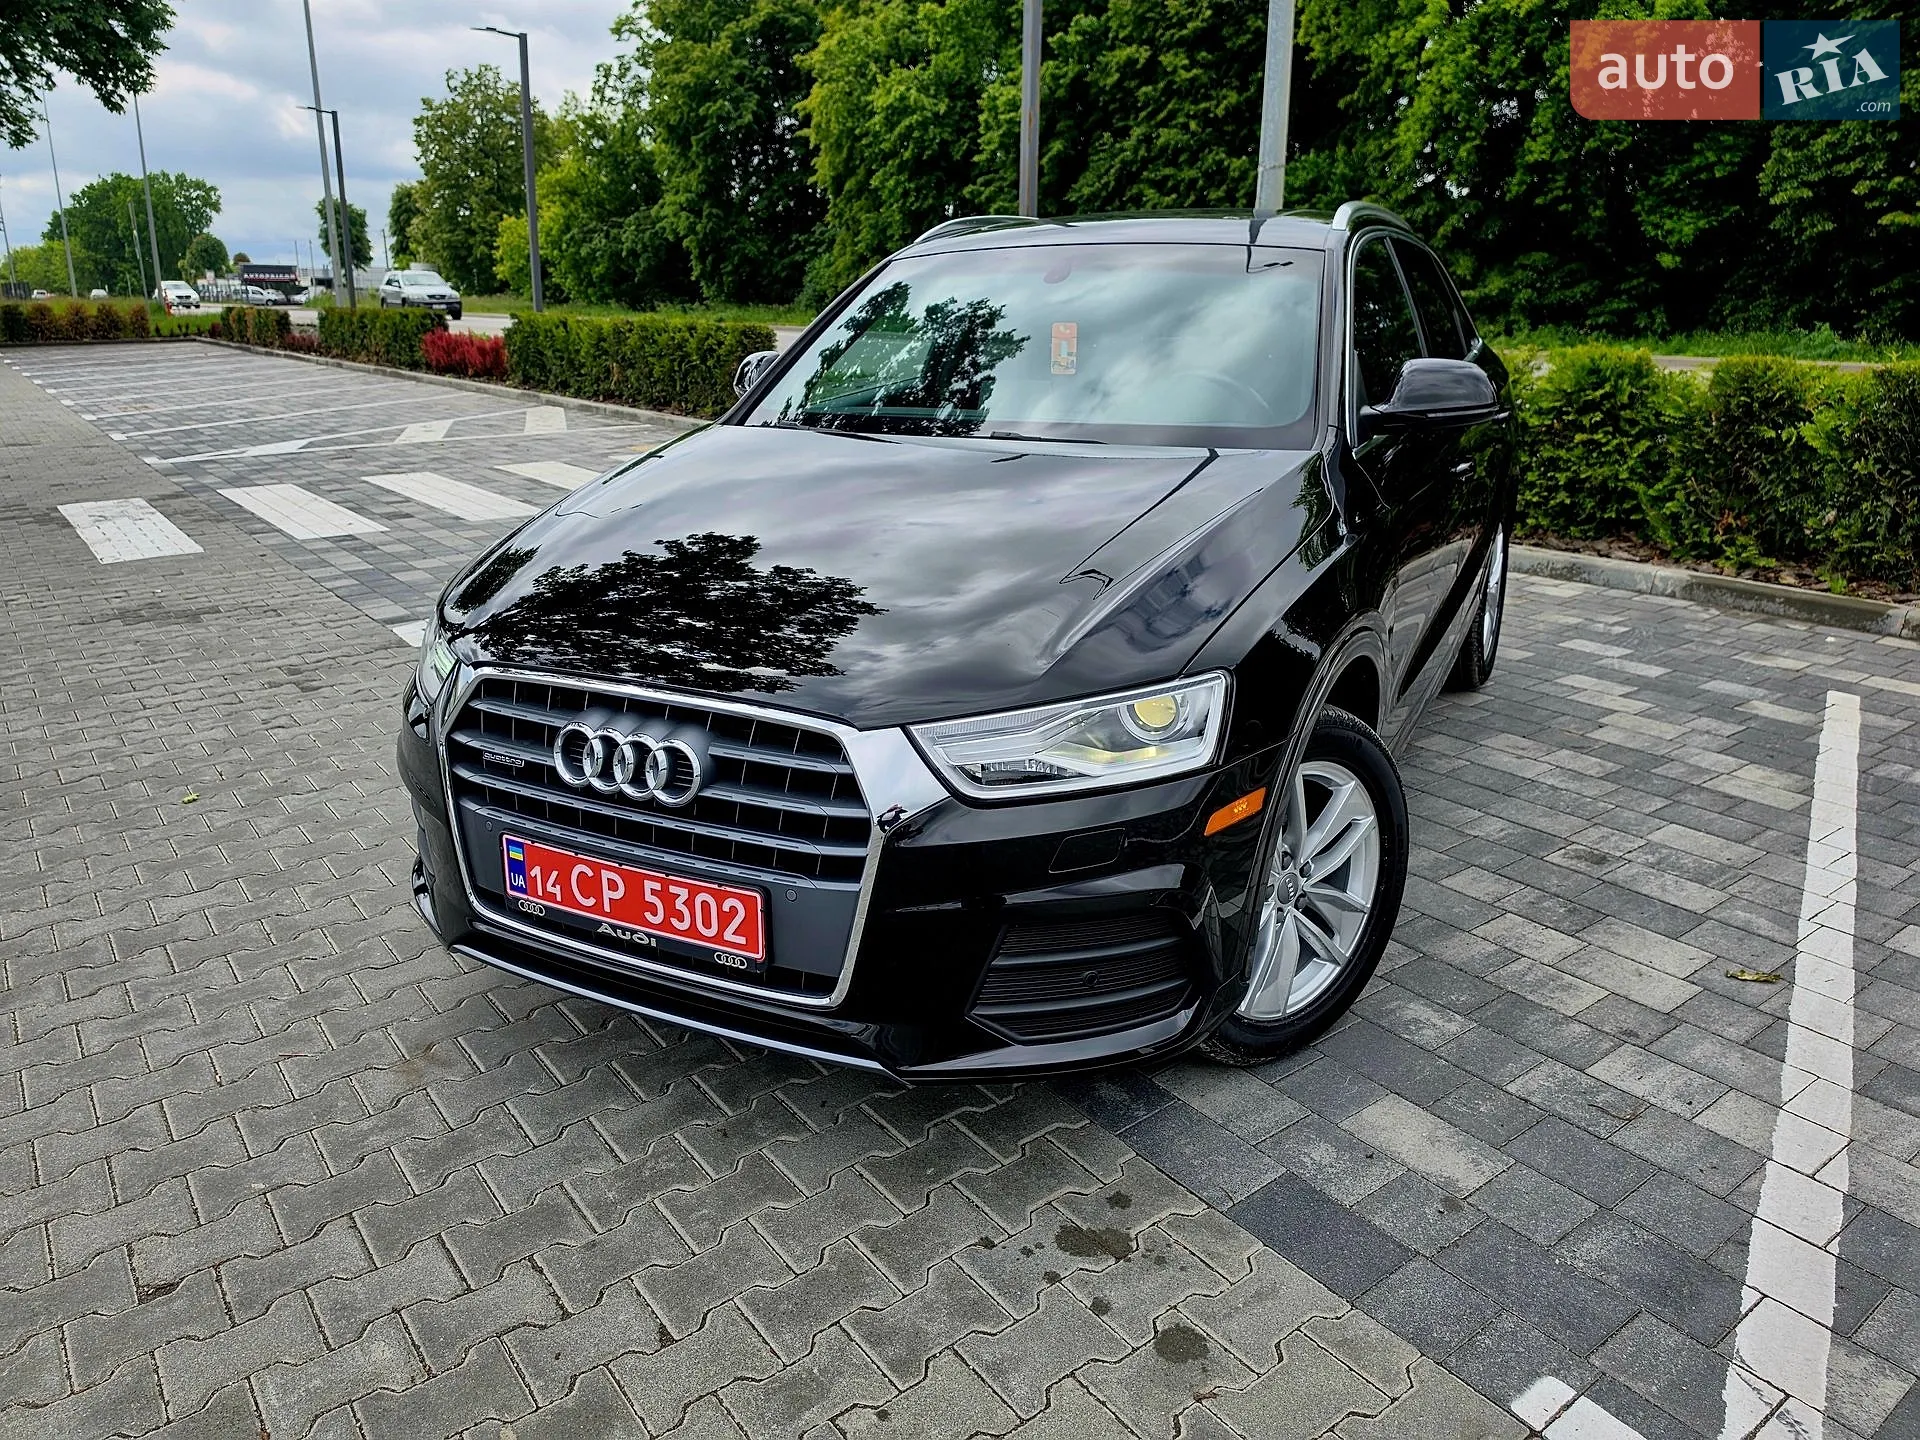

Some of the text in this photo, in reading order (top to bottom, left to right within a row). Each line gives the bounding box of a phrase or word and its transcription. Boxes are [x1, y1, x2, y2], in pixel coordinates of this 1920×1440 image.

[483, 752, 522, 765] quattro
[511, 872, 526, 889] UA
[529, 864, 747, 945] 14 CP 5302
